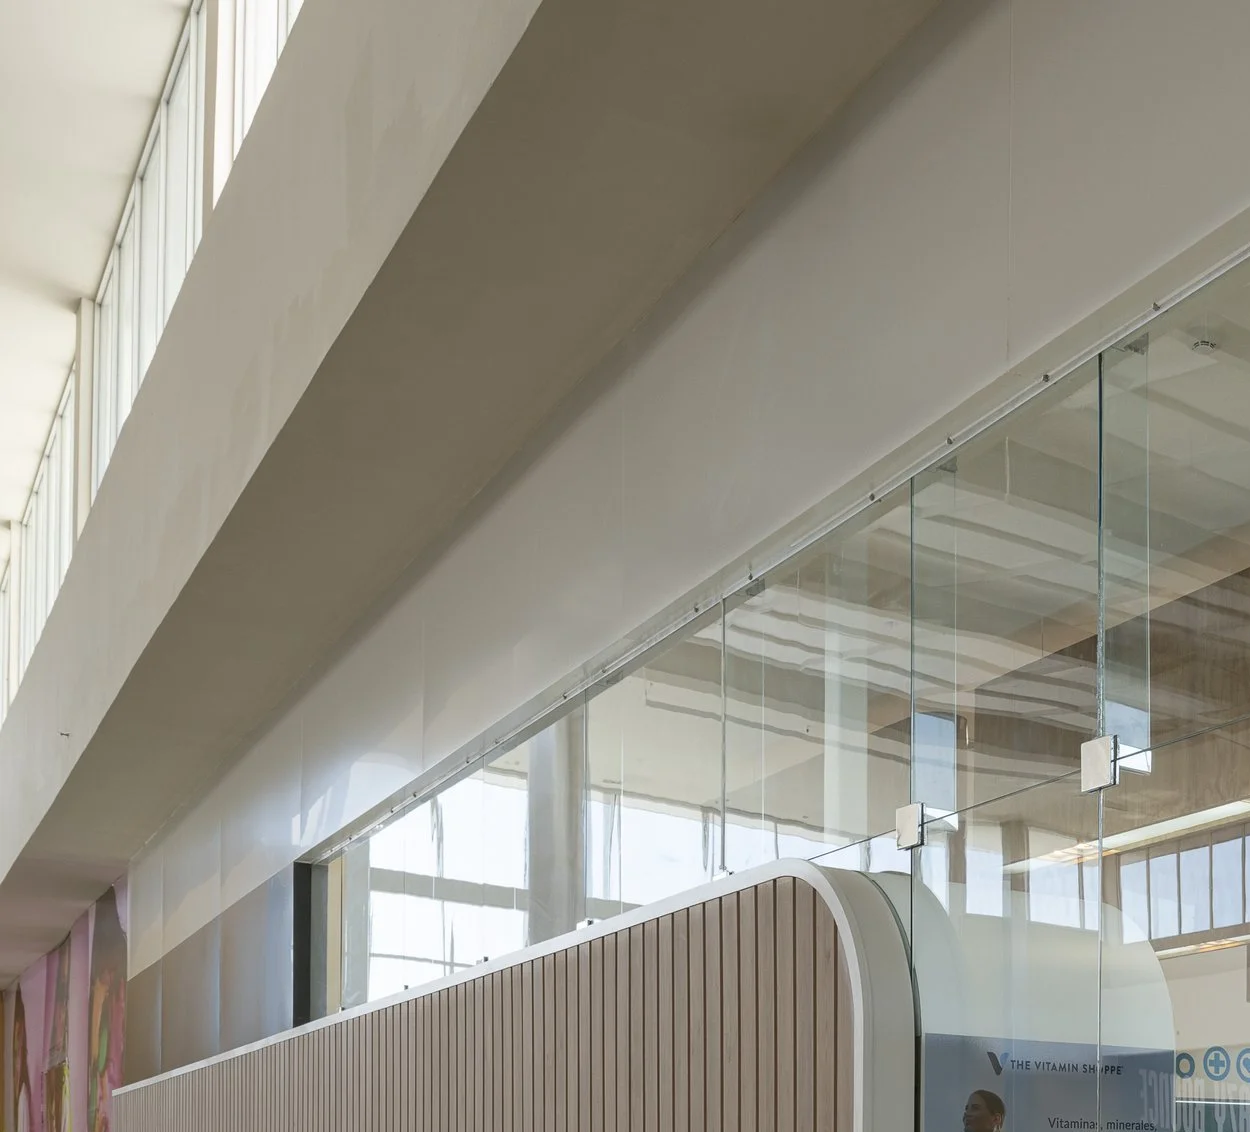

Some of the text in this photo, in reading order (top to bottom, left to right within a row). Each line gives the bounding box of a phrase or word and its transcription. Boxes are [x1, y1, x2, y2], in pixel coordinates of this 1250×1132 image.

[1010, 1060, 1031, 1070] THE
[1034, 1061, 1079, 1073] VITAMIN
[1106, 1119, 1158, 1132] minerales,
